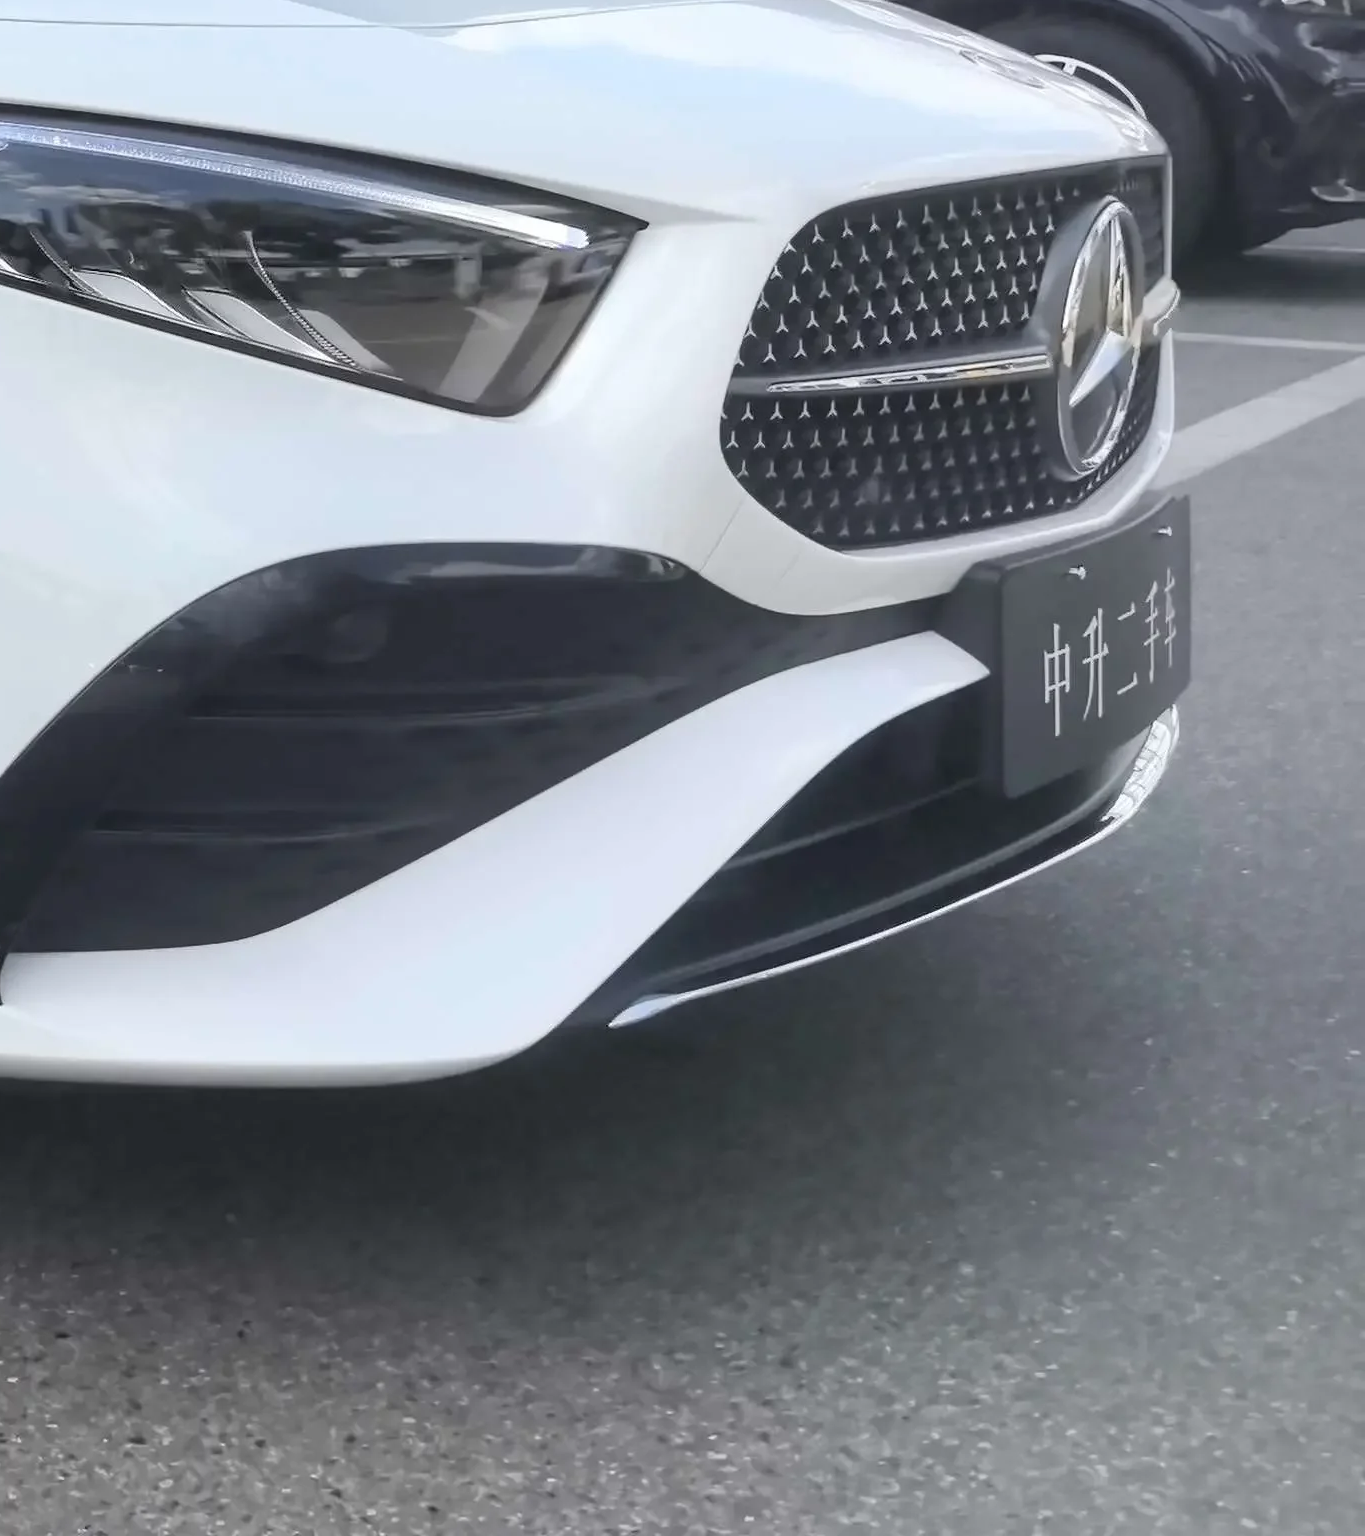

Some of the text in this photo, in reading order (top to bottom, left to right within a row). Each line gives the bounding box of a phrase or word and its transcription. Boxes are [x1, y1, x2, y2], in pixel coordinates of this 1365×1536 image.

[1044, 567, 1177, 737] 中升二手车
